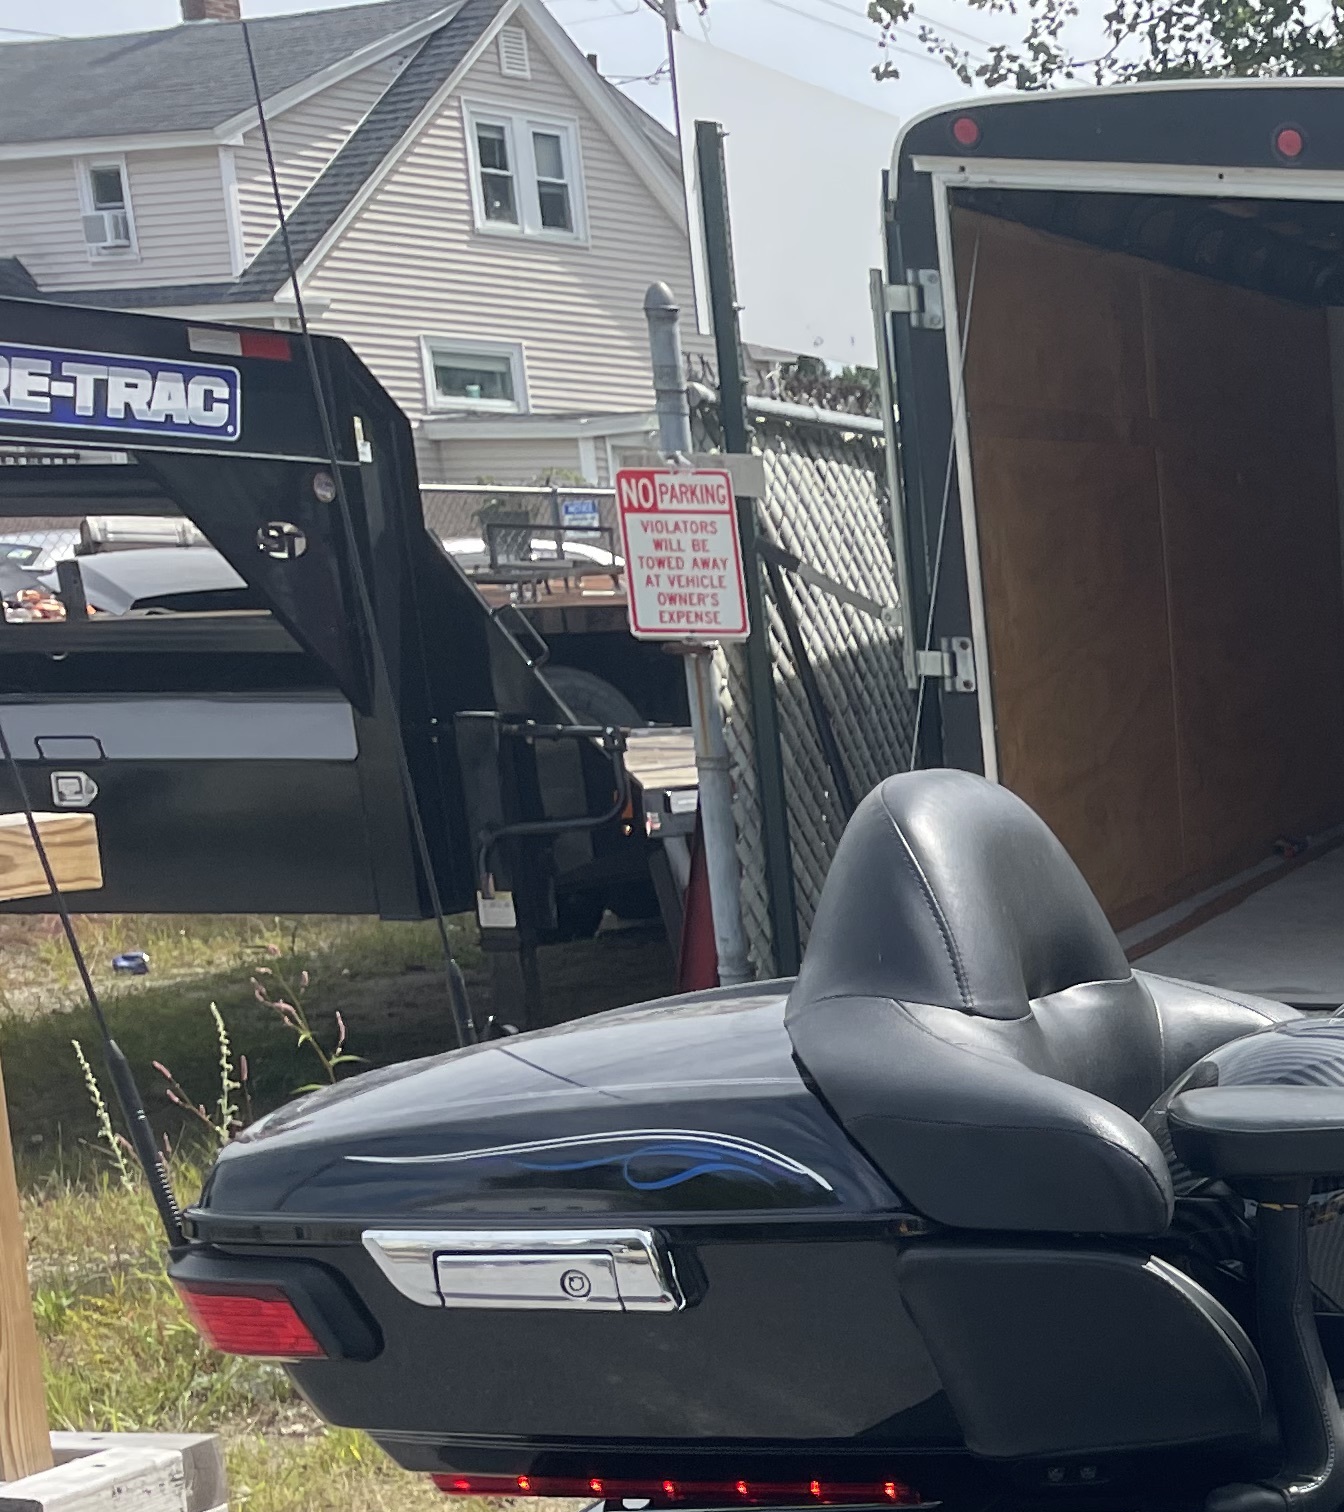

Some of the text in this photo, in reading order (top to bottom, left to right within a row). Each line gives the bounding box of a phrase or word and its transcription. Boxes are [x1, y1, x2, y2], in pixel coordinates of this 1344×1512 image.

[0, 354, 230, 428] E-TRAC
[620, 477, 727, 509] NO PARKING
[640, 519, 718, 535] VIOLATORS
[652, 538, 709, 553] WILL BE
[638, 555, 729, 572] TOWED AWAY
[645, 574, 727, 590] AT VEHICLE
[657, 591, 720, 607] OWNER'S
[659, 610, 722, 625] EXPENSE
